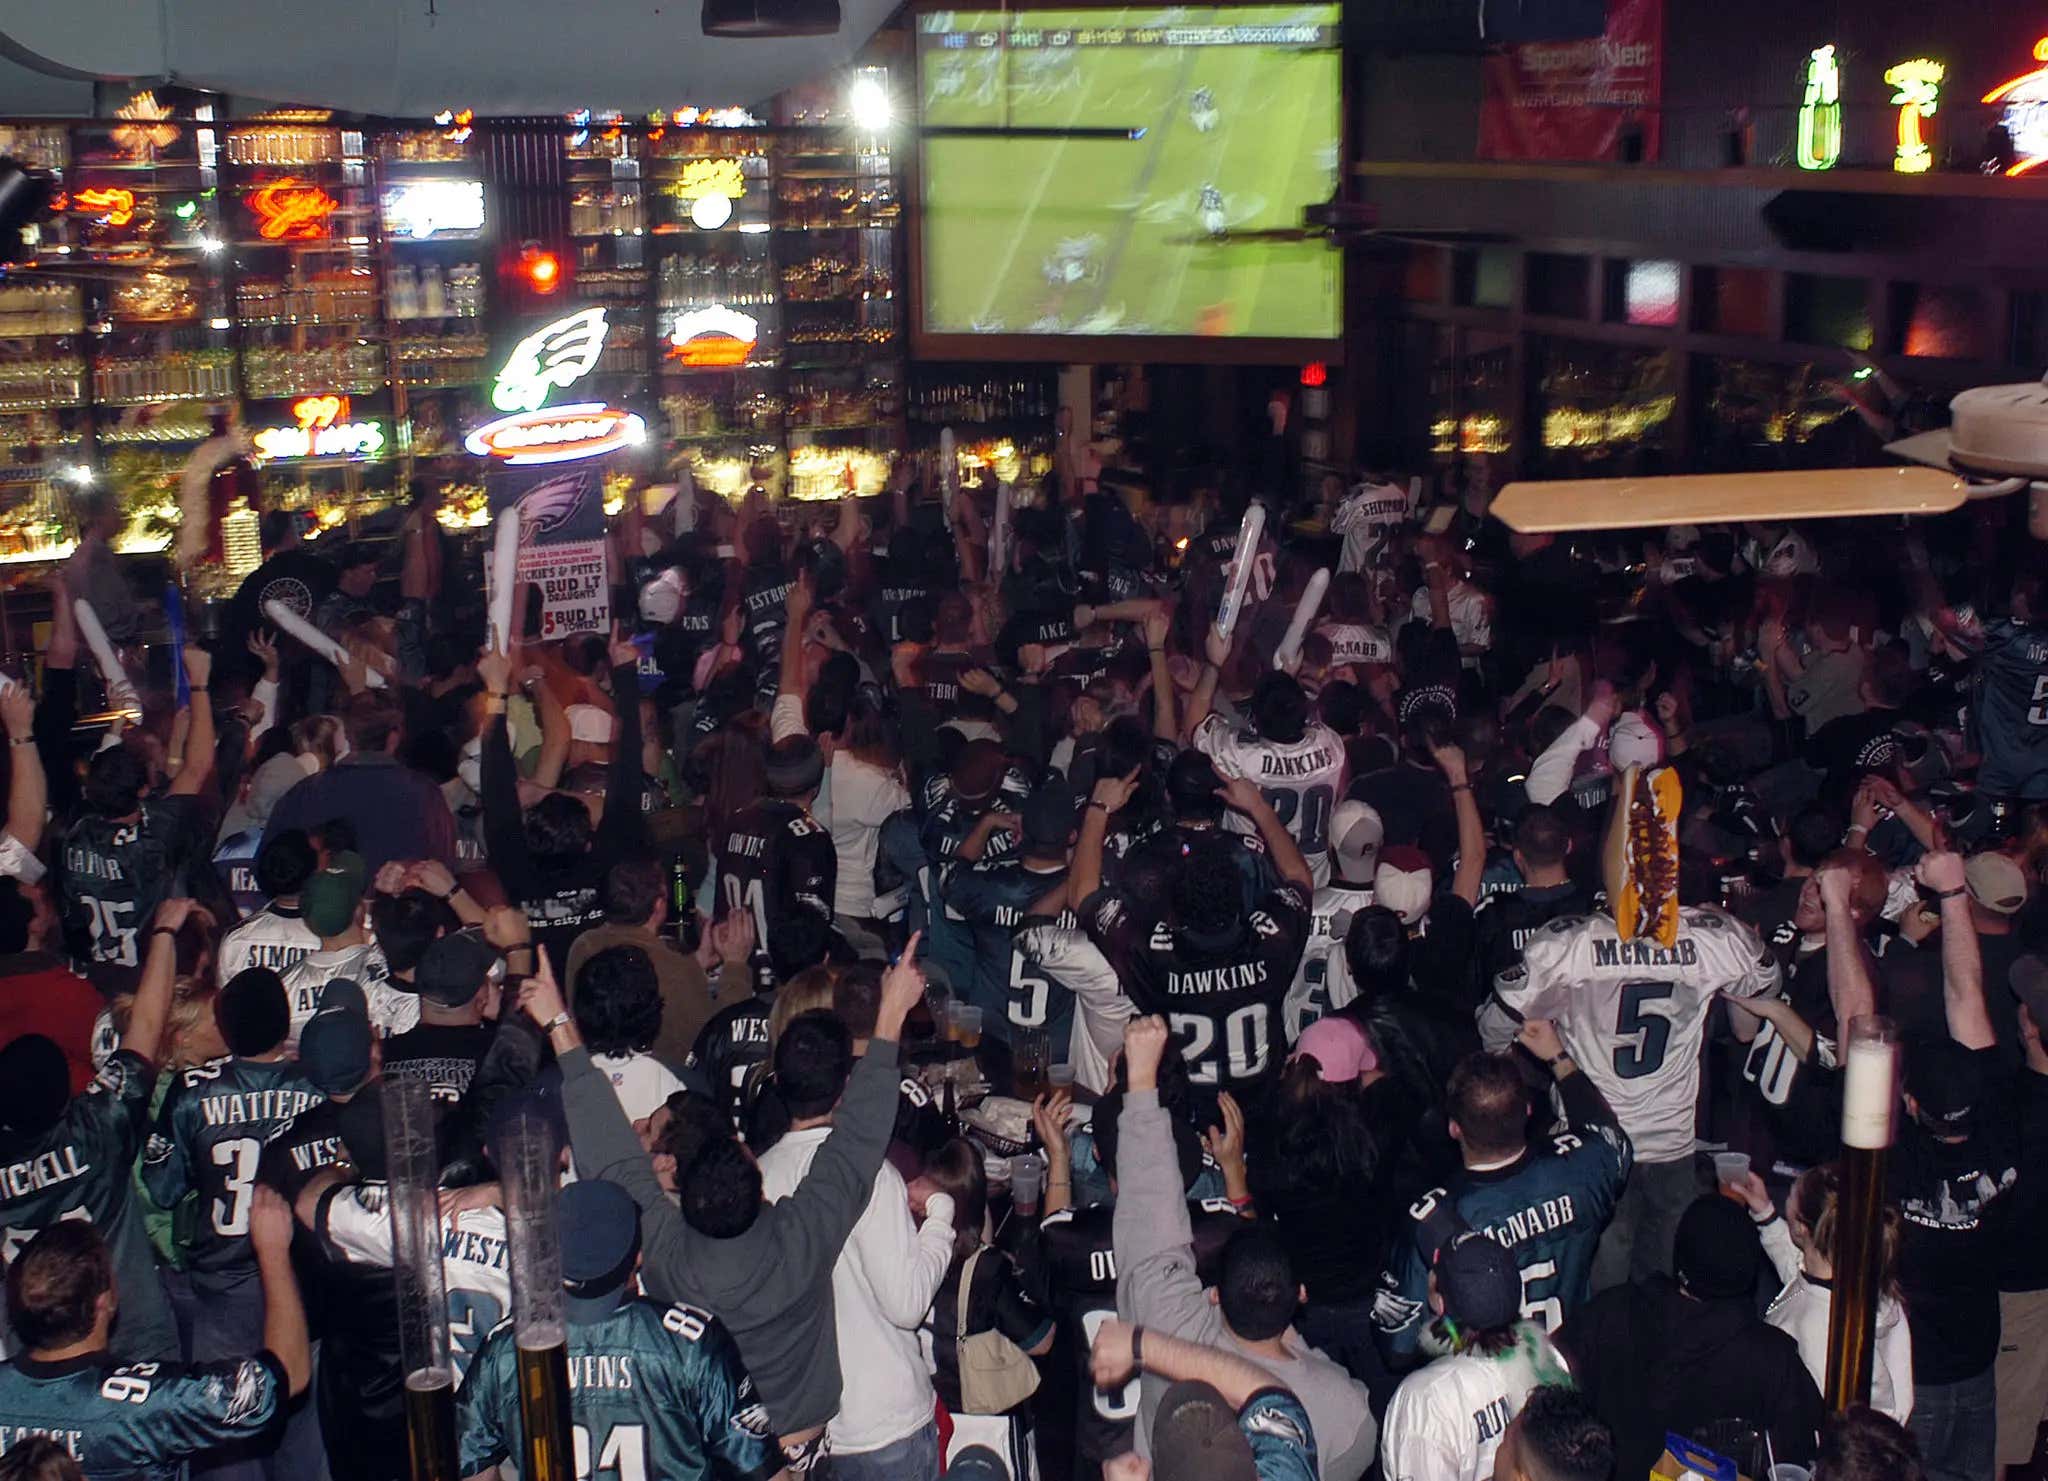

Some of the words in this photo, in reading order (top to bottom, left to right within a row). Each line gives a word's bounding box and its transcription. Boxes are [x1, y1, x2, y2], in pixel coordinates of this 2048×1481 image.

[545, 578, 579, 594] BUD
[584, 576, 601, 589] LT
[547, 590, 597, 602] DRAUGHTS
[544, 611, 556, 634] 5
[555, 609, 587, 624] BUD
[592, 607, 608, 621] LT
[1261, 747, 1333, 775] DAWKINS
[1007, 949, 1049, 1027] 5
[1167, 960, 1268, 995] DAWKINS
[1168, 1002, 1269, 1085] 20
[1612, 981, 1674, 1080] 5
